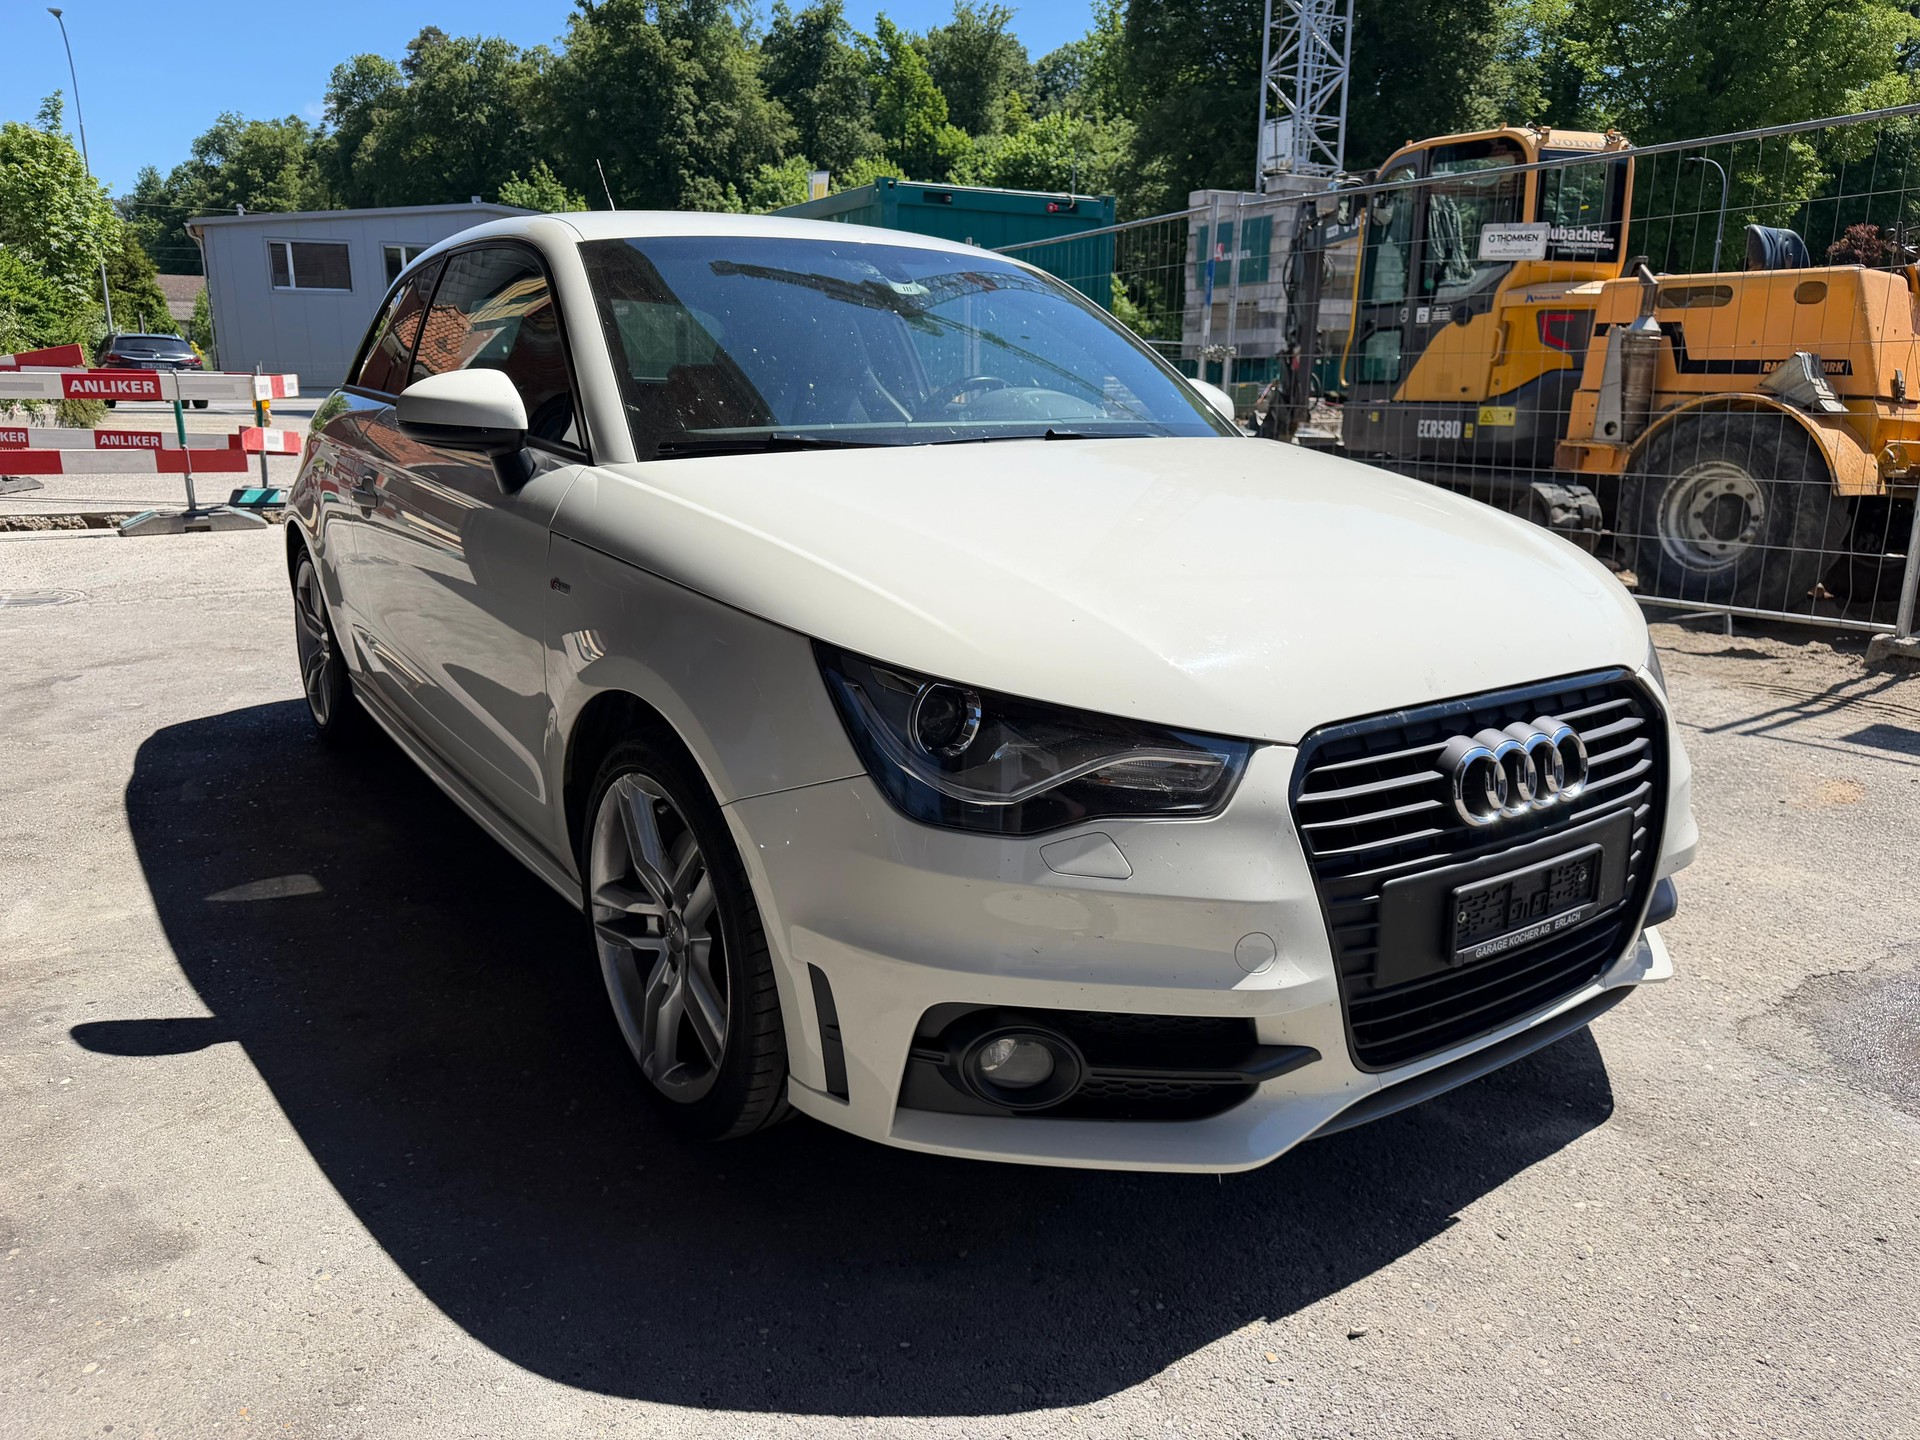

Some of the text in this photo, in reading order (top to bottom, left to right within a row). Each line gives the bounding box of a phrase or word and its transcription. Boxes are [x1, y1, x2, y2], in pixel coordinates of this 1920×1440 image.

[1551, 139, 1605, 148] VOLVO
[1496, 233, 1539, 243] THOMMEN
[69, 380, 156, 393] ANLIKER
[1417, 419, 1461, 439] ECR58D
[100, 434, 160, 447] ANLIKER
[1475, 911, 1581, 958] GARAGE KOCHER AG ERLACH
